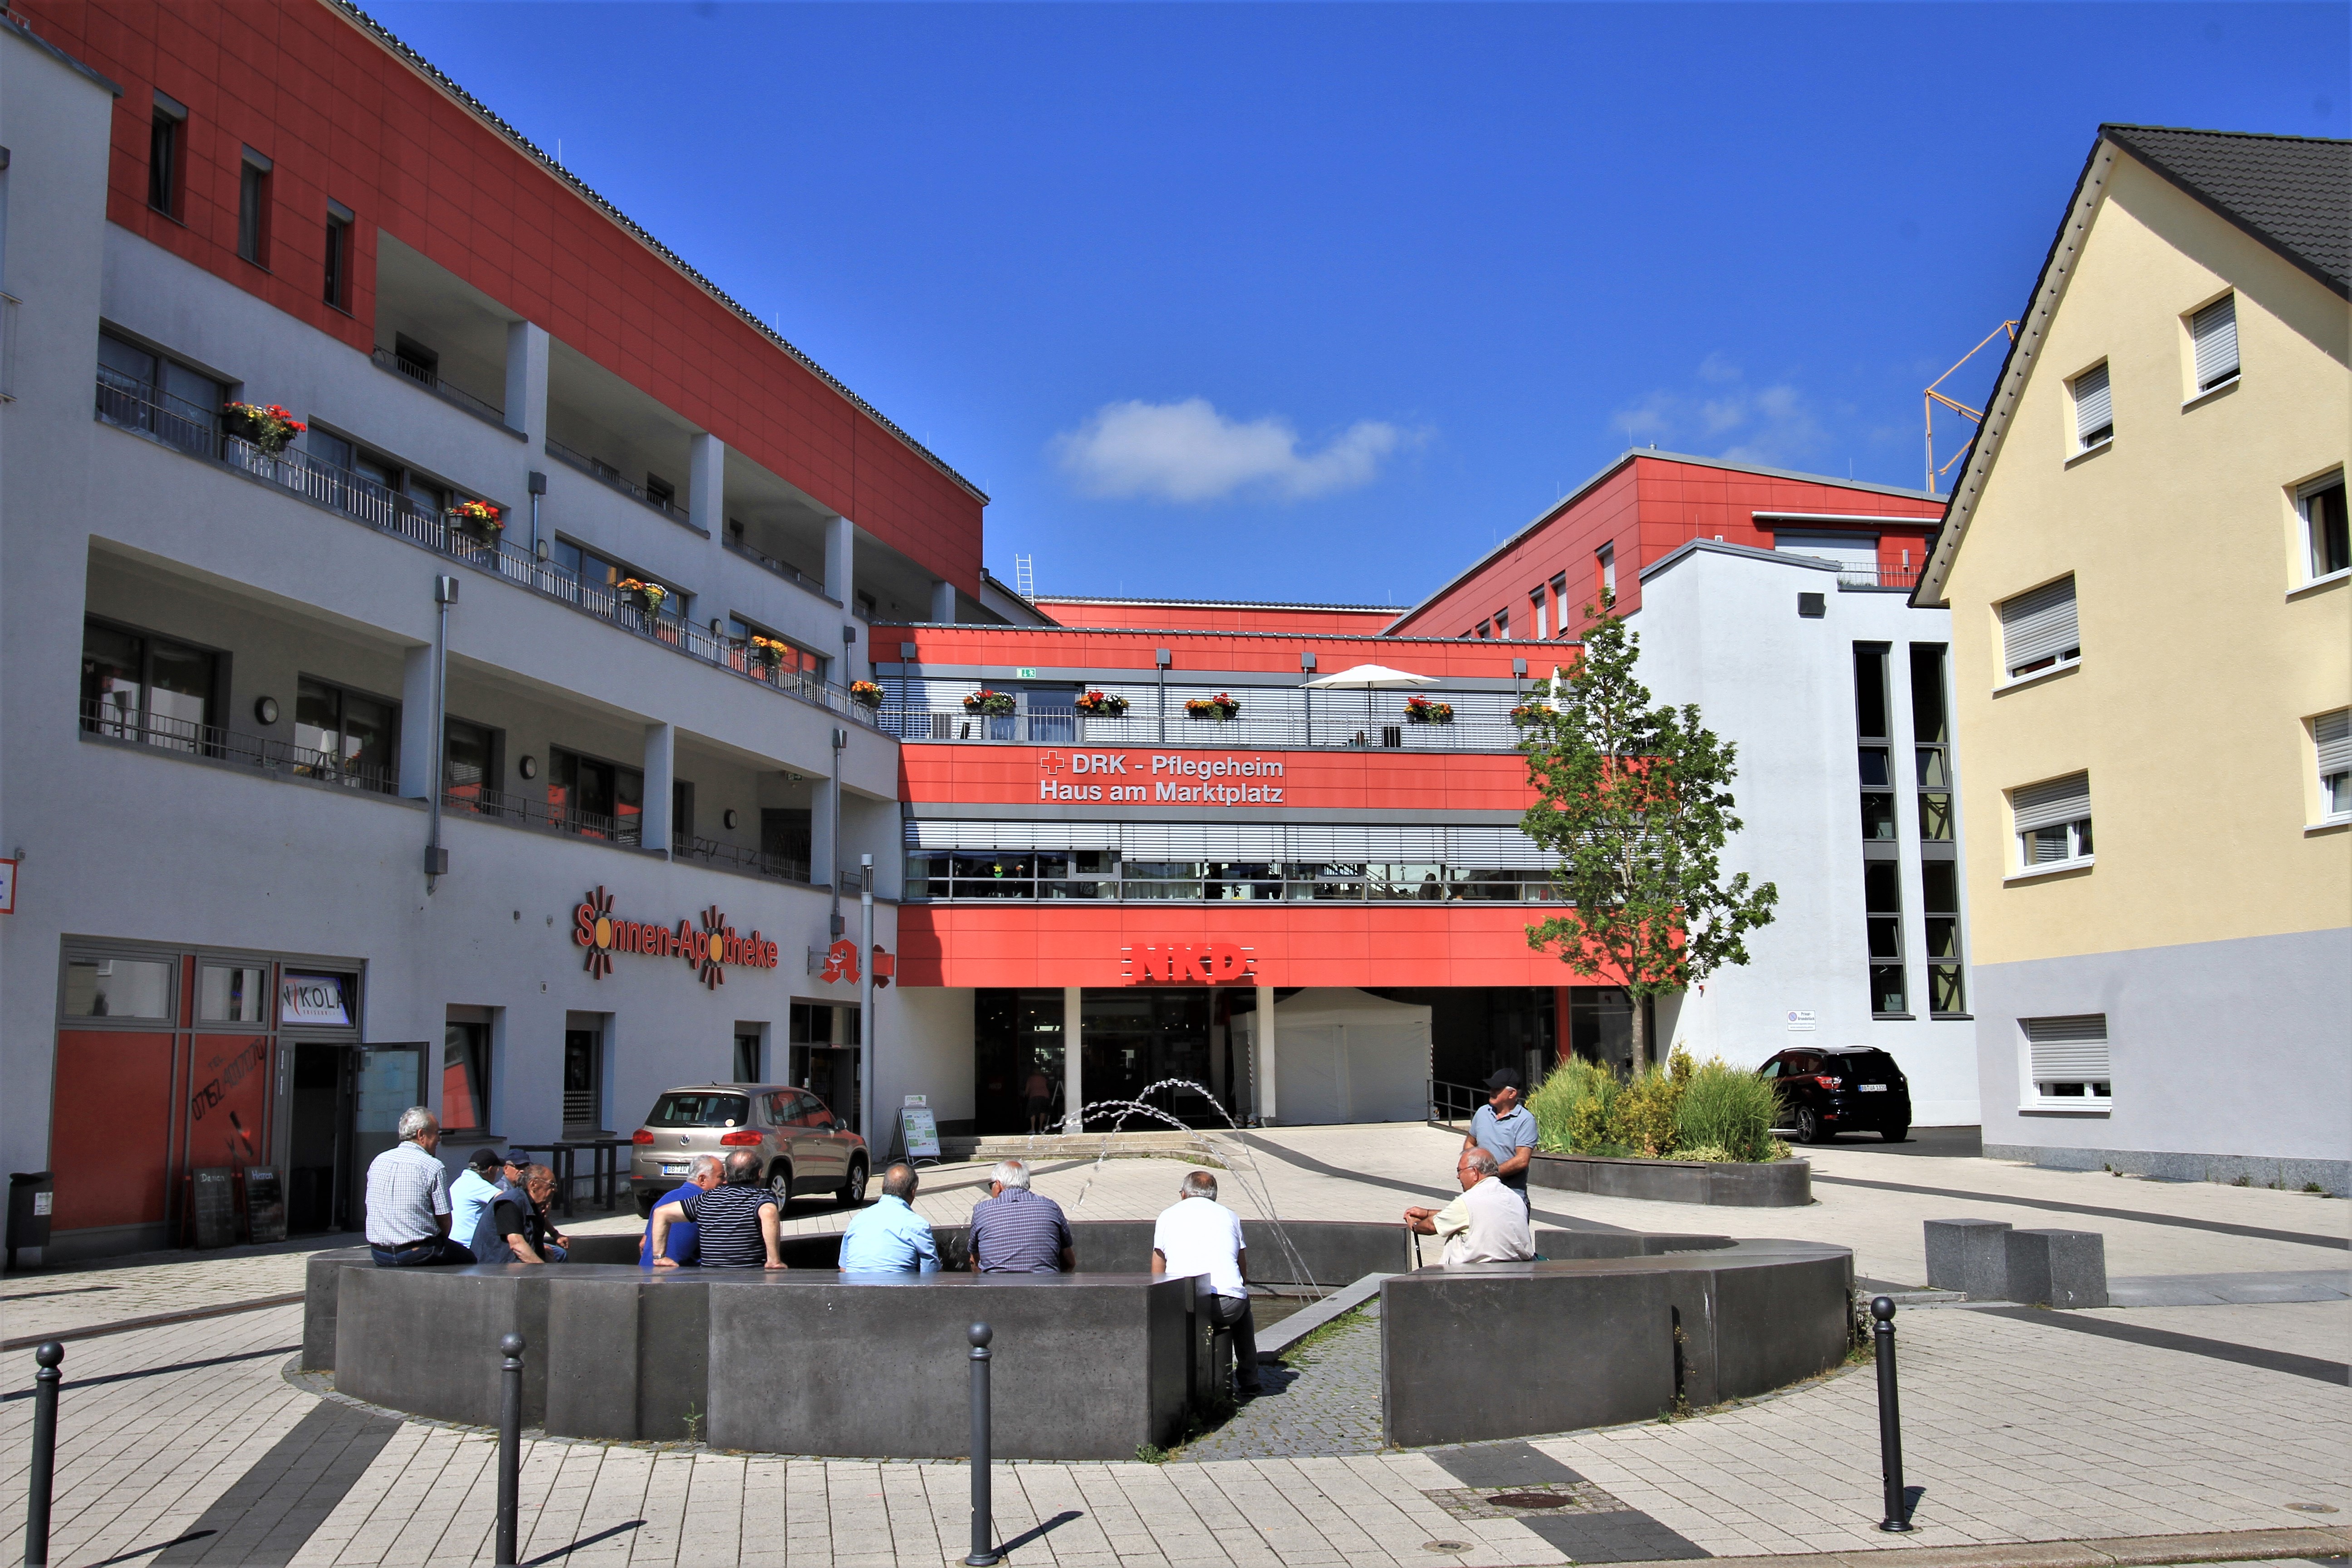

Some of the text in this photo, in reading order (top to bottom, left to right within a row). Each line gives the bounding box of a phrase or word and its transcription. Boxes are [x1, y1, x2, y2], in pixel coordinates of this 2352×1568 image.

[1073, 754, 1127, 774] DRK
[1152, 755, 1283, 780] Pflegeheim
[1040, 780, 1284, 806] Haus am Marktplatz
[574, 903, 778, 970] Sonnen-Apotheke
[1131, 943, 1246, 980] NKD
